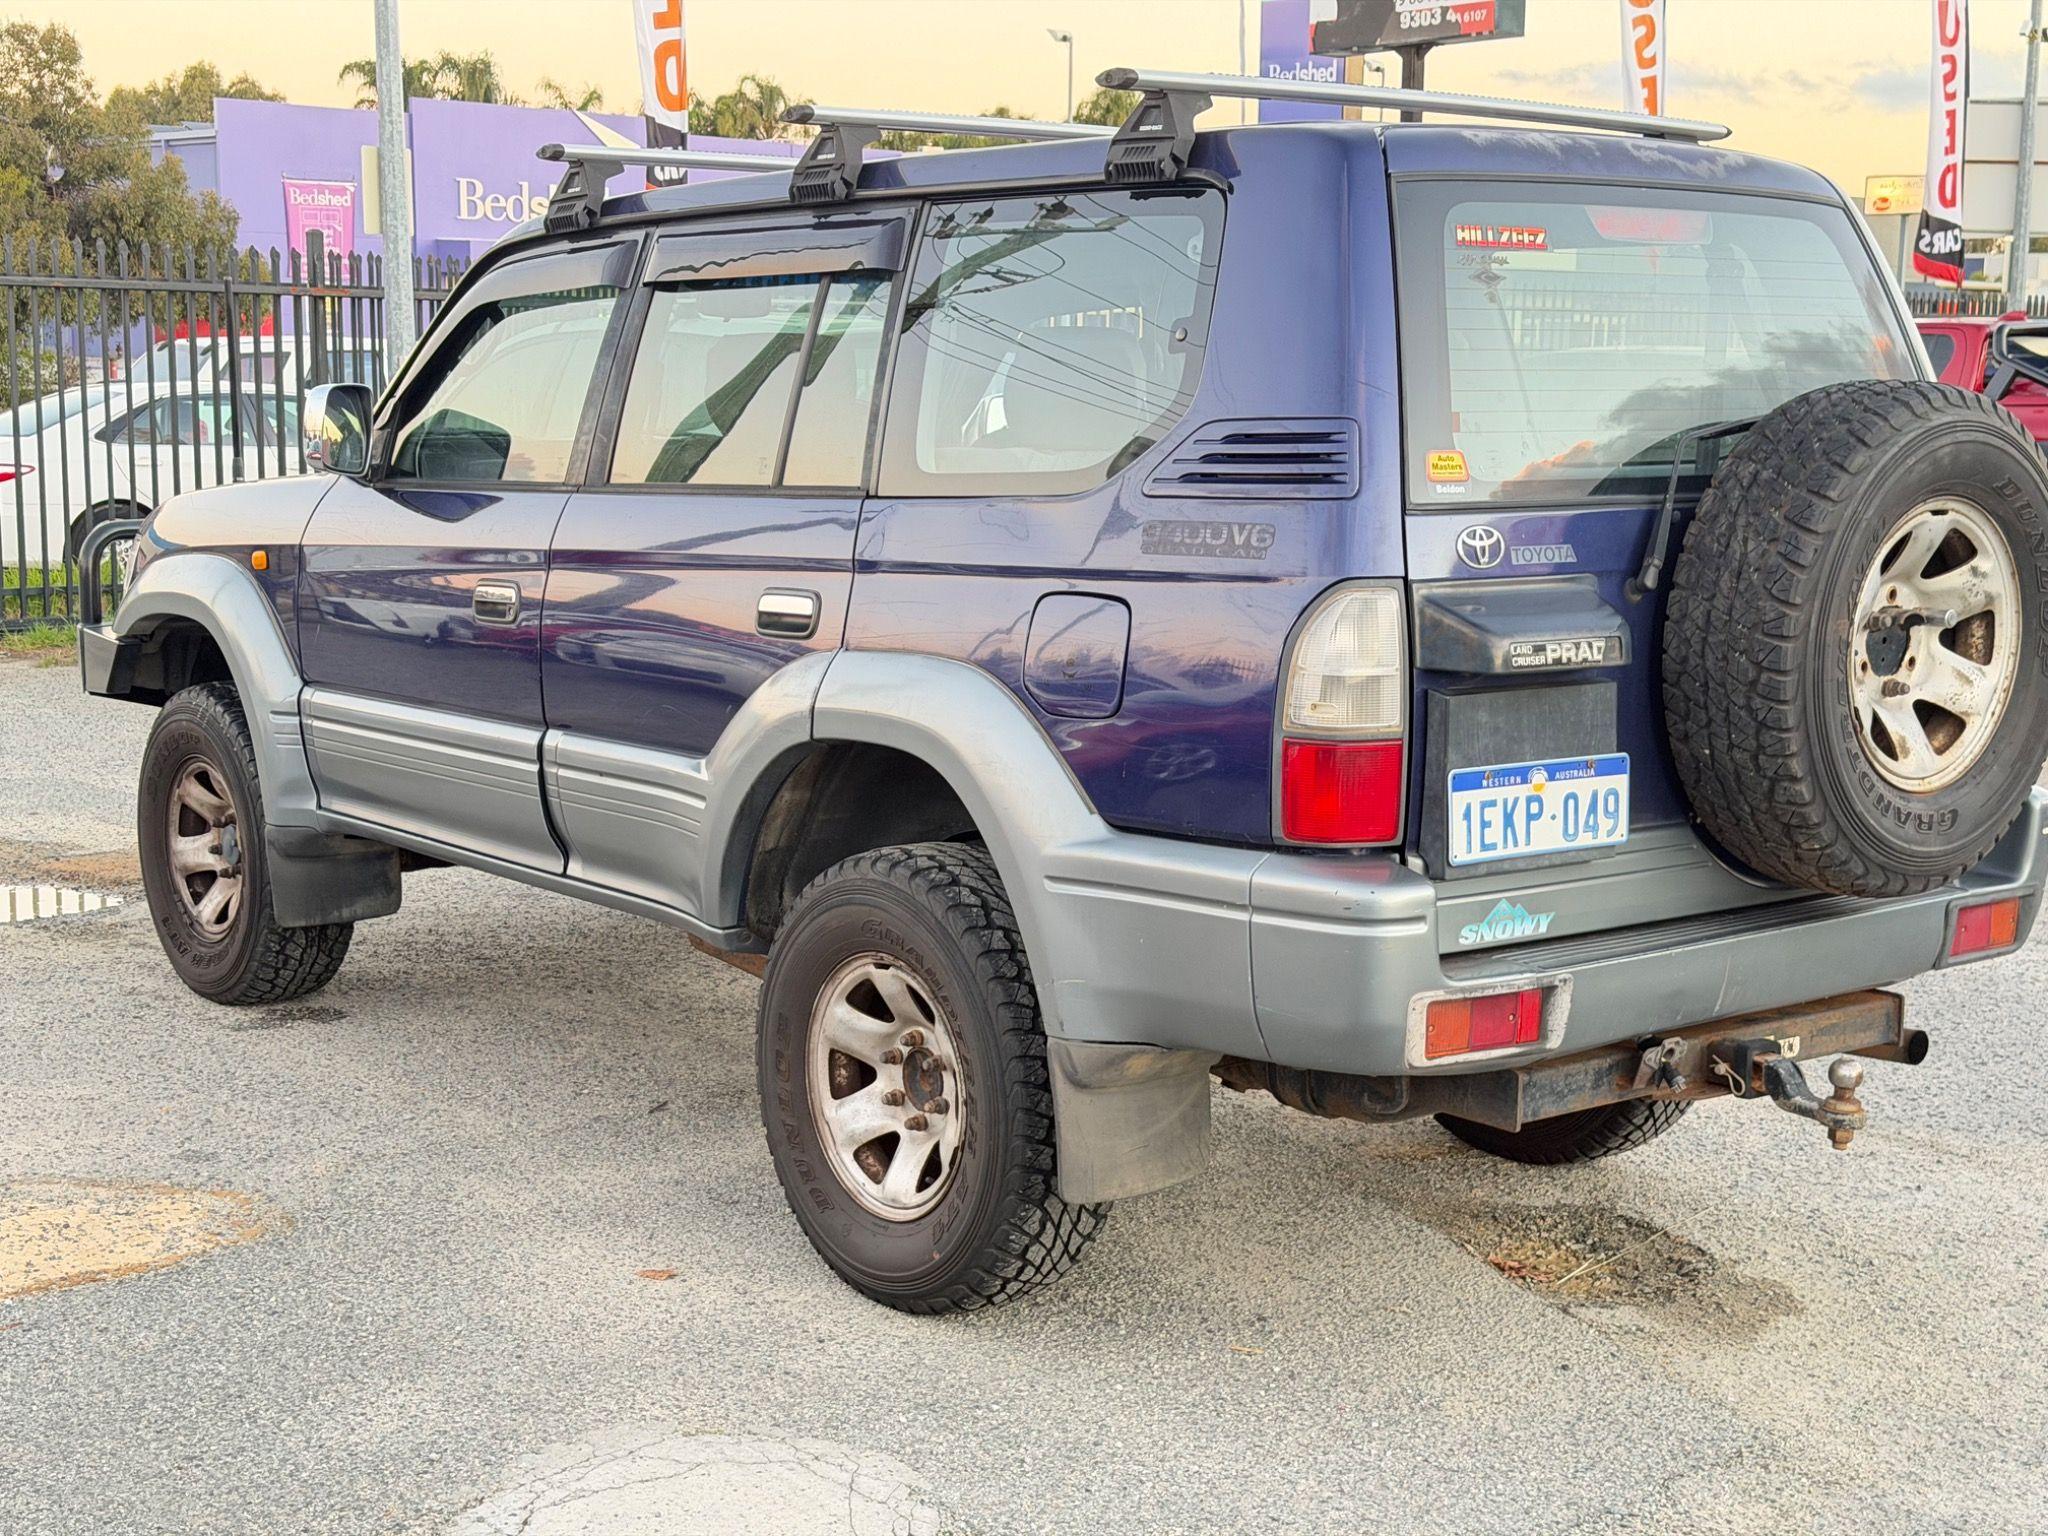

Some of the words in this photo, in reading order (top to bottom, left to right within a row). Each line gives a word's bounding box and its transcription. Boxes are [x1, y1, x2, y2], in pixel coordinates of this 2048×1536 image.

[1400, 8, 1441, 29] 9303
[1463, 9, 1487, 23] 6107
[289, 187, 351, 207] Bedshed
[1456, 224, 1547, 249] HILLZEEZ
[1432, 462, 1463, 471] Masters
[1511, 545, 1576, 564] TOYOTA
[1510, 643, 1534, 656] LAND
[1511, 655, 1547, 668] CRUISER
[1481, 775, 1522, 788] WESTERN
[1554, 767, 1596, 780] AUSTRALIA
[1458, 911, 1556, 945] SNOWY
